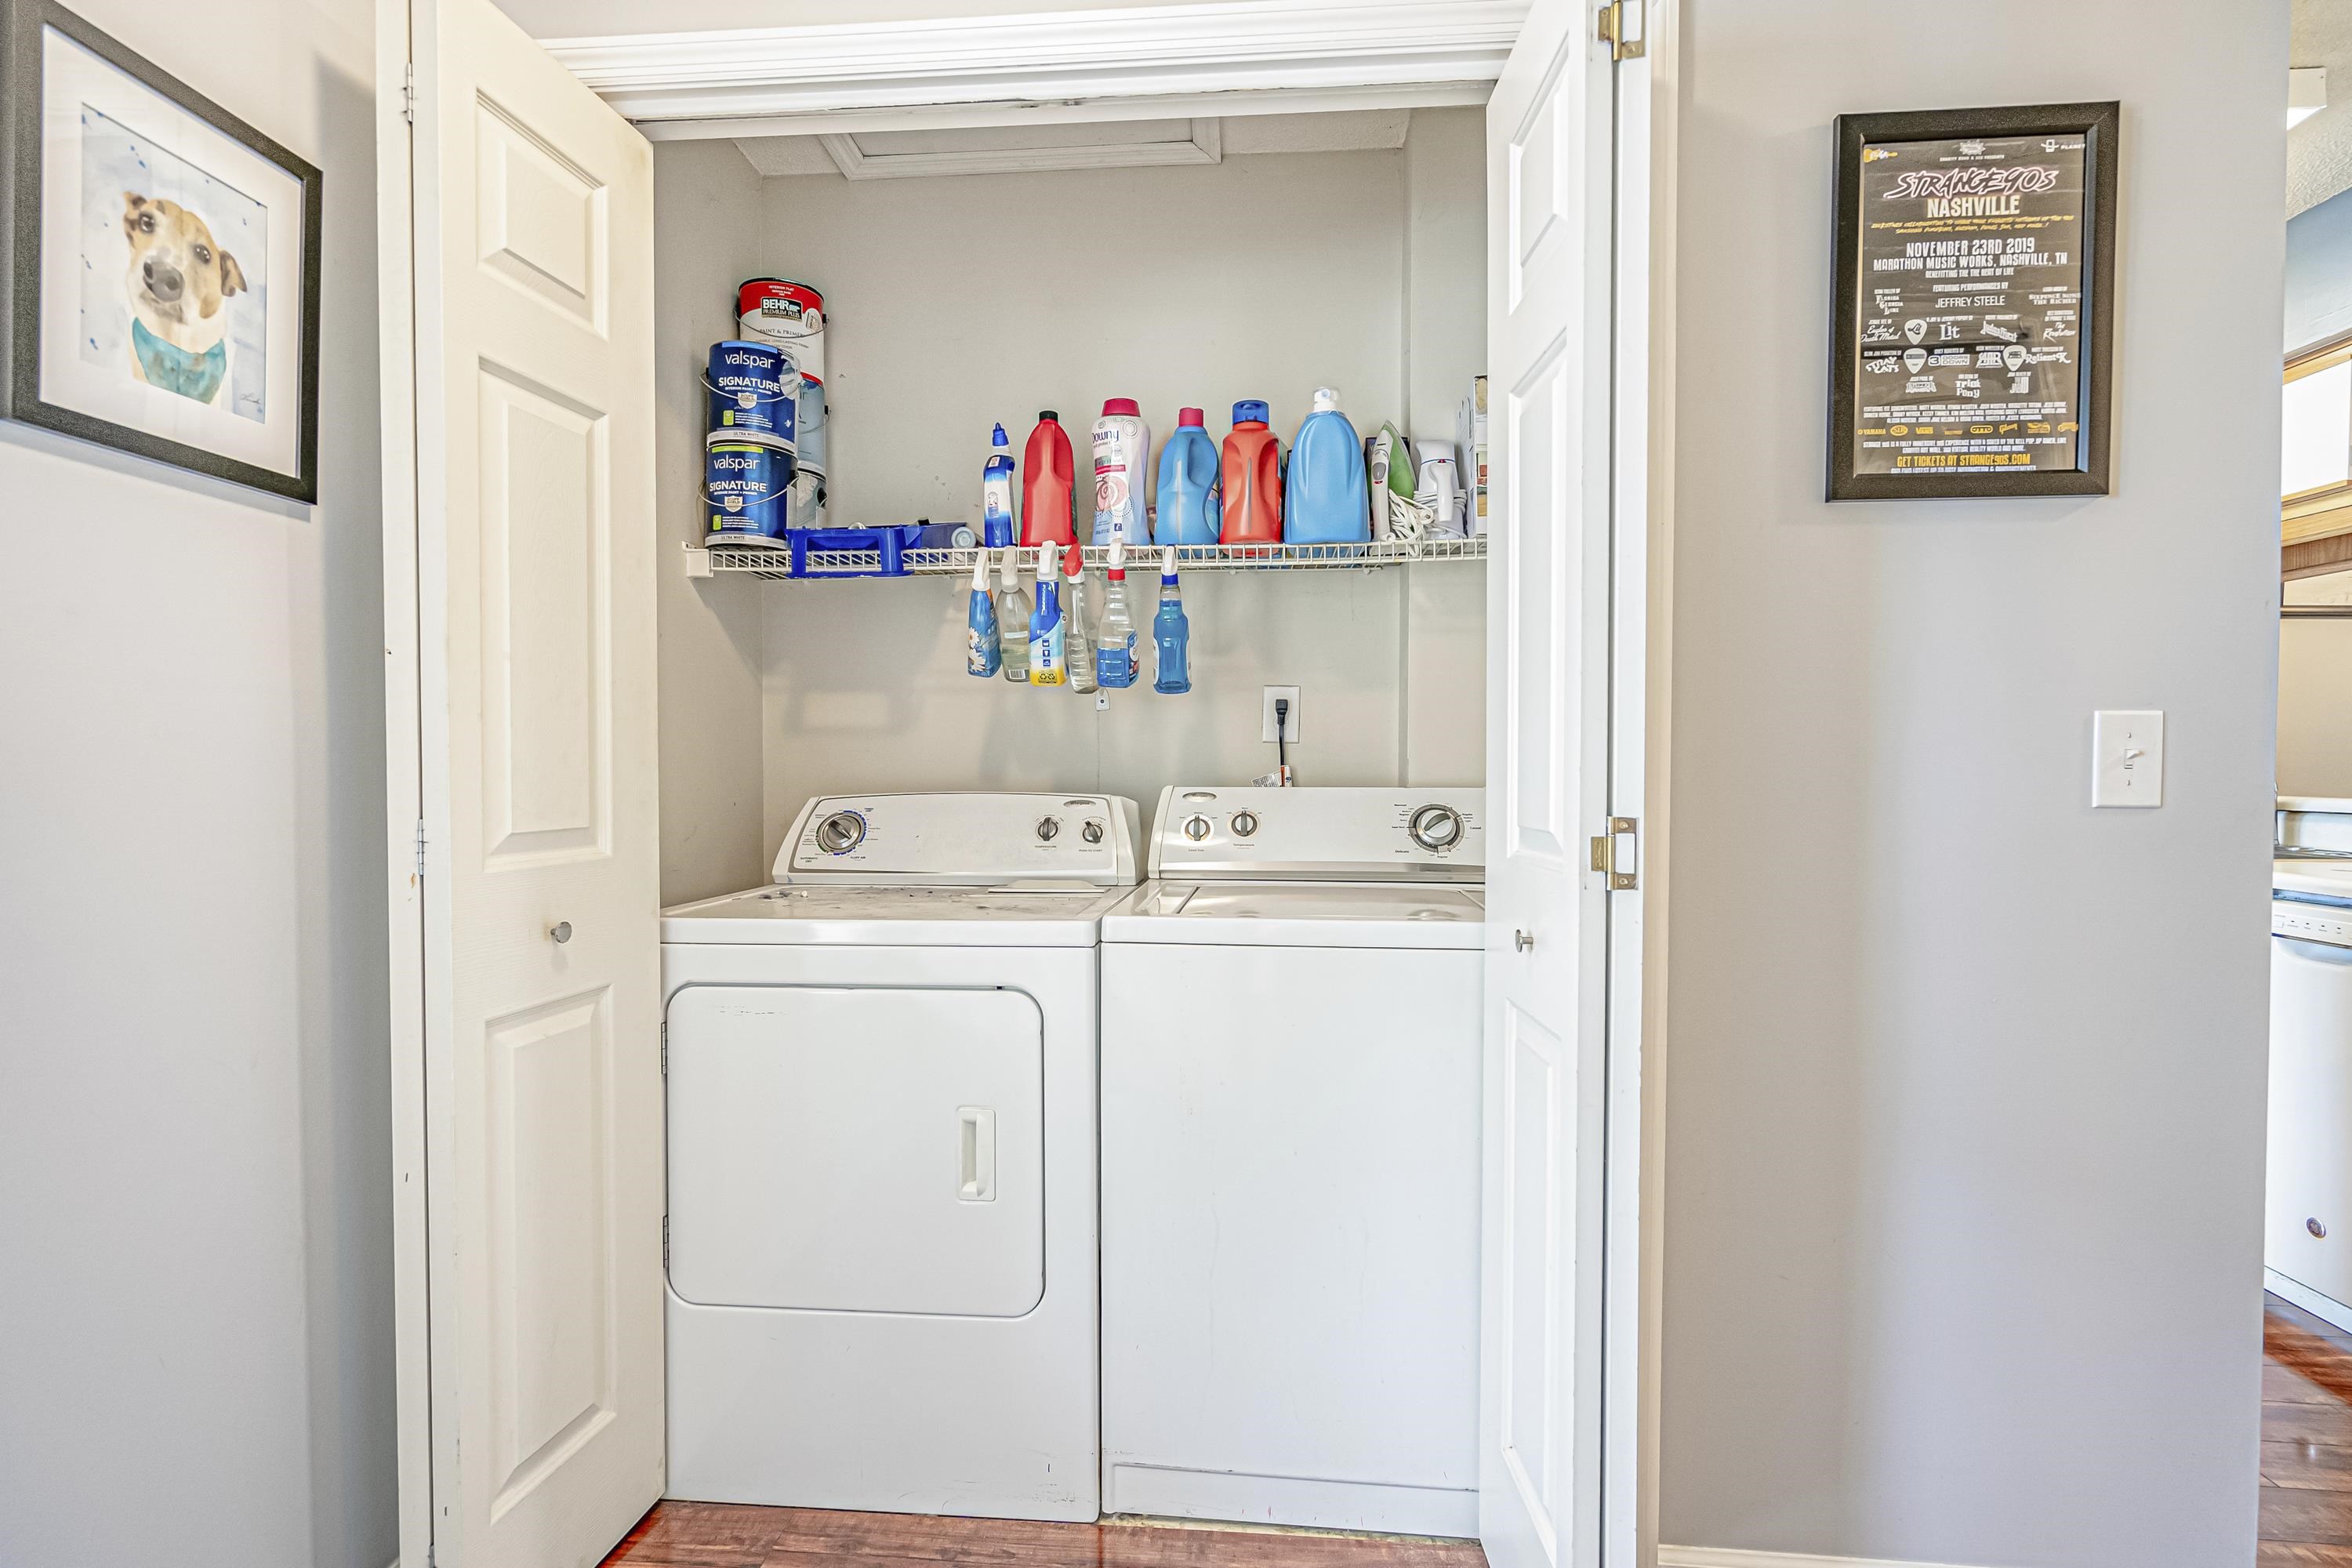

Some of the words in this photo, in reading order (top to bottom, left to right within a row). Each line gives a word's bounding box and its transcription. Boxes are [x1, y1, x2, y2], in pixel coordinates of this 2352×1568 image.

[1926, 196, 2021, 219] NASHVILLE
[1906, 241, 1969, 257] NOVEMBER
[1972, 239, 2002, 255] 23RD
[2006, 238, 2035, 253] 2019
[1873, 258, 1923, 271] MARATHON
[1926, 256, 1957, 269] MUSIC
[1959, 255, 1997, 267] WORKS,
[2000, 252, 2053, 267] NASHVILLE,
[2055, 252, 2068, 265] TN
[763, 299, 789, 310] BEHR
[1935, 297, 1973, 308] JEFFREY
[1973, 295, 2006, 307] STEELE
[787, 310, 800, 318] PLUS
[1939, 321, 1961, 340] Lit
[724, 350, 775, 368] valspar
[1929, 356, 1939, 365] 3
[718, 376, 781, 393] SIGNATURE
[1091, 430, 1119, 443] Downy
[713, 454, 760, 472] valspar
[1897, 456, 1911, 467] GET
[1914, 456, 1946, 466] TICKETS
[1947, 455, 1958, 466] AT
[710, 480, 768, 492] SIGNATURE
